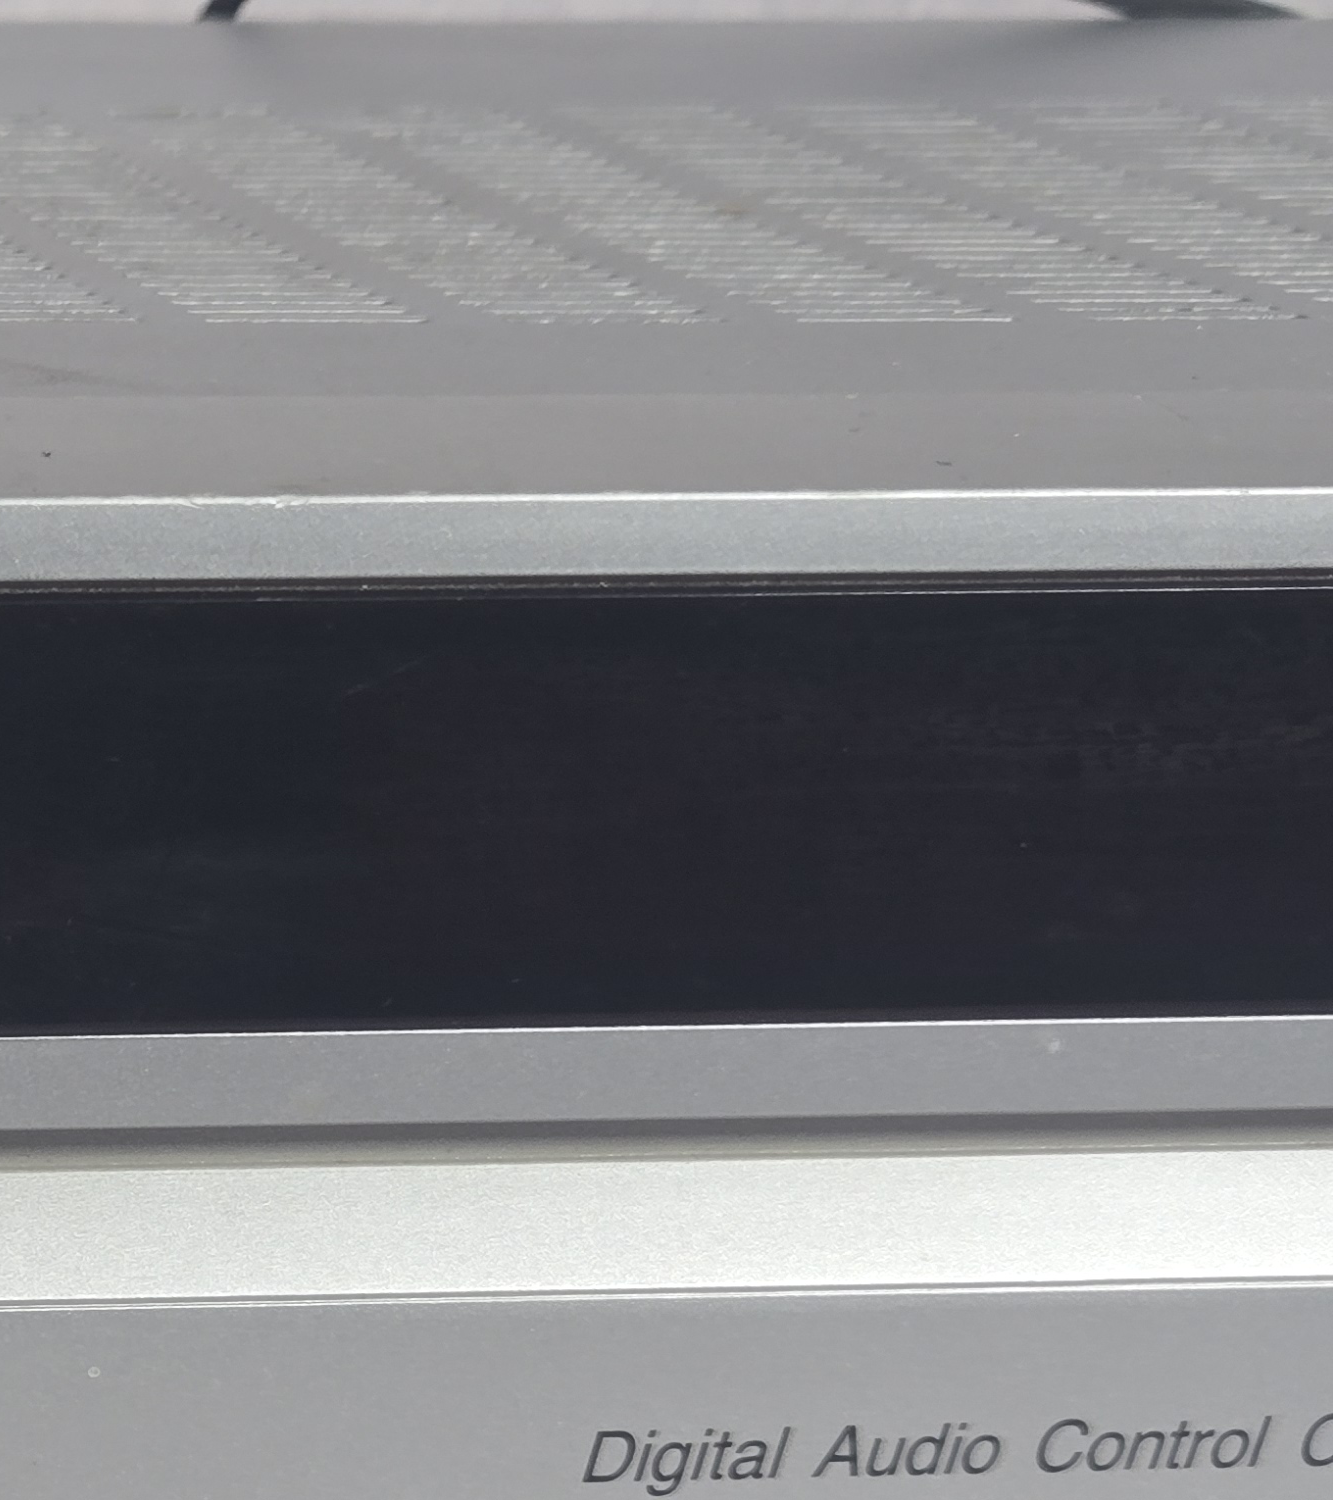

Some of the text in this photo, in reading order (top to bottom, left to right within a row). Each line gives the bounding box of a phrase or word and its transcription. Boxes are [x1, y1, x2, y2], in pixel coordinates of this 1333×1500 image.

[581, 1425, 793, 1498] Digital
[810, 1421, 1003, 1479] Audio
[1035, 1414, 1274, 1475] Control
